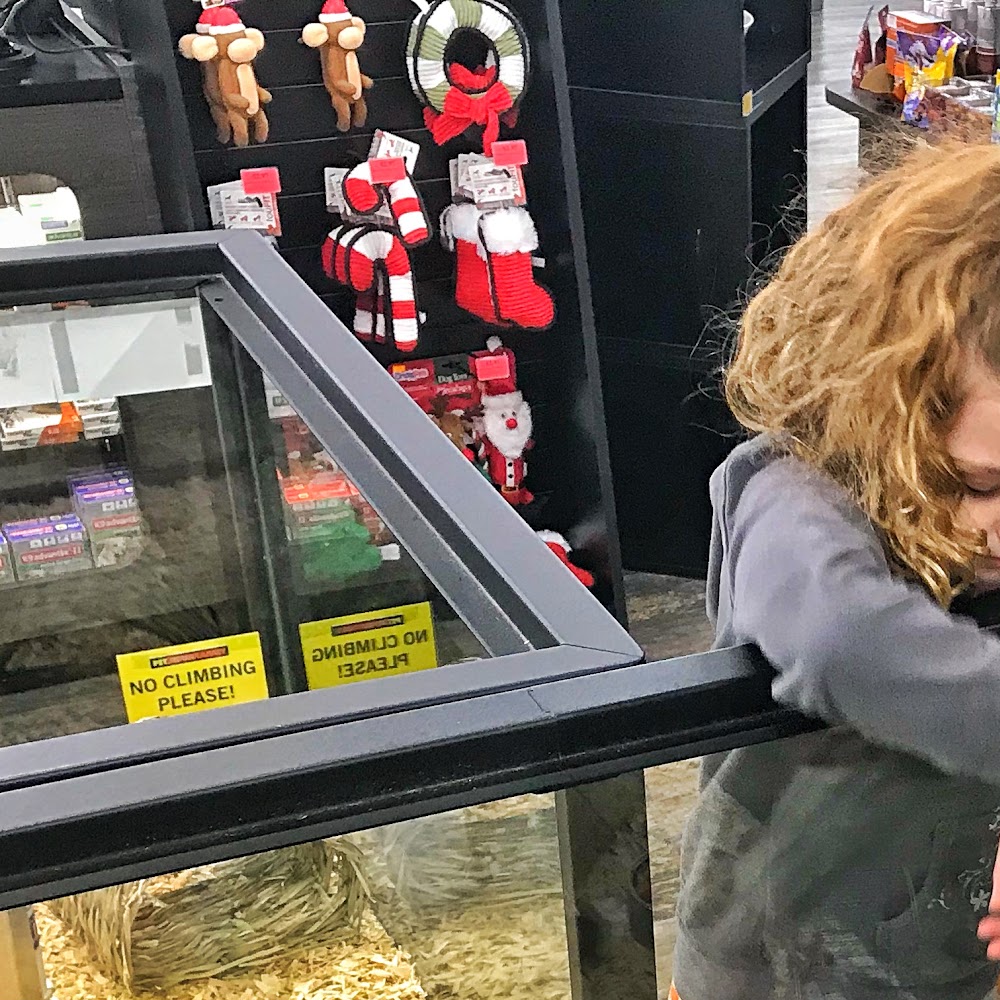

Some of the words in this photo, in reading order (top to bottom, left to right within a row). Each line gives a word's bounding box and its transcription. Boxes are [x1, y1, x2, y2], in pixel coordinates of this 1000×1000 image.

[129, 678, 158, 696] NO
[163, 660, 257, 690] CLIMBING
[158, 684, 236, 712] PLEASE!
